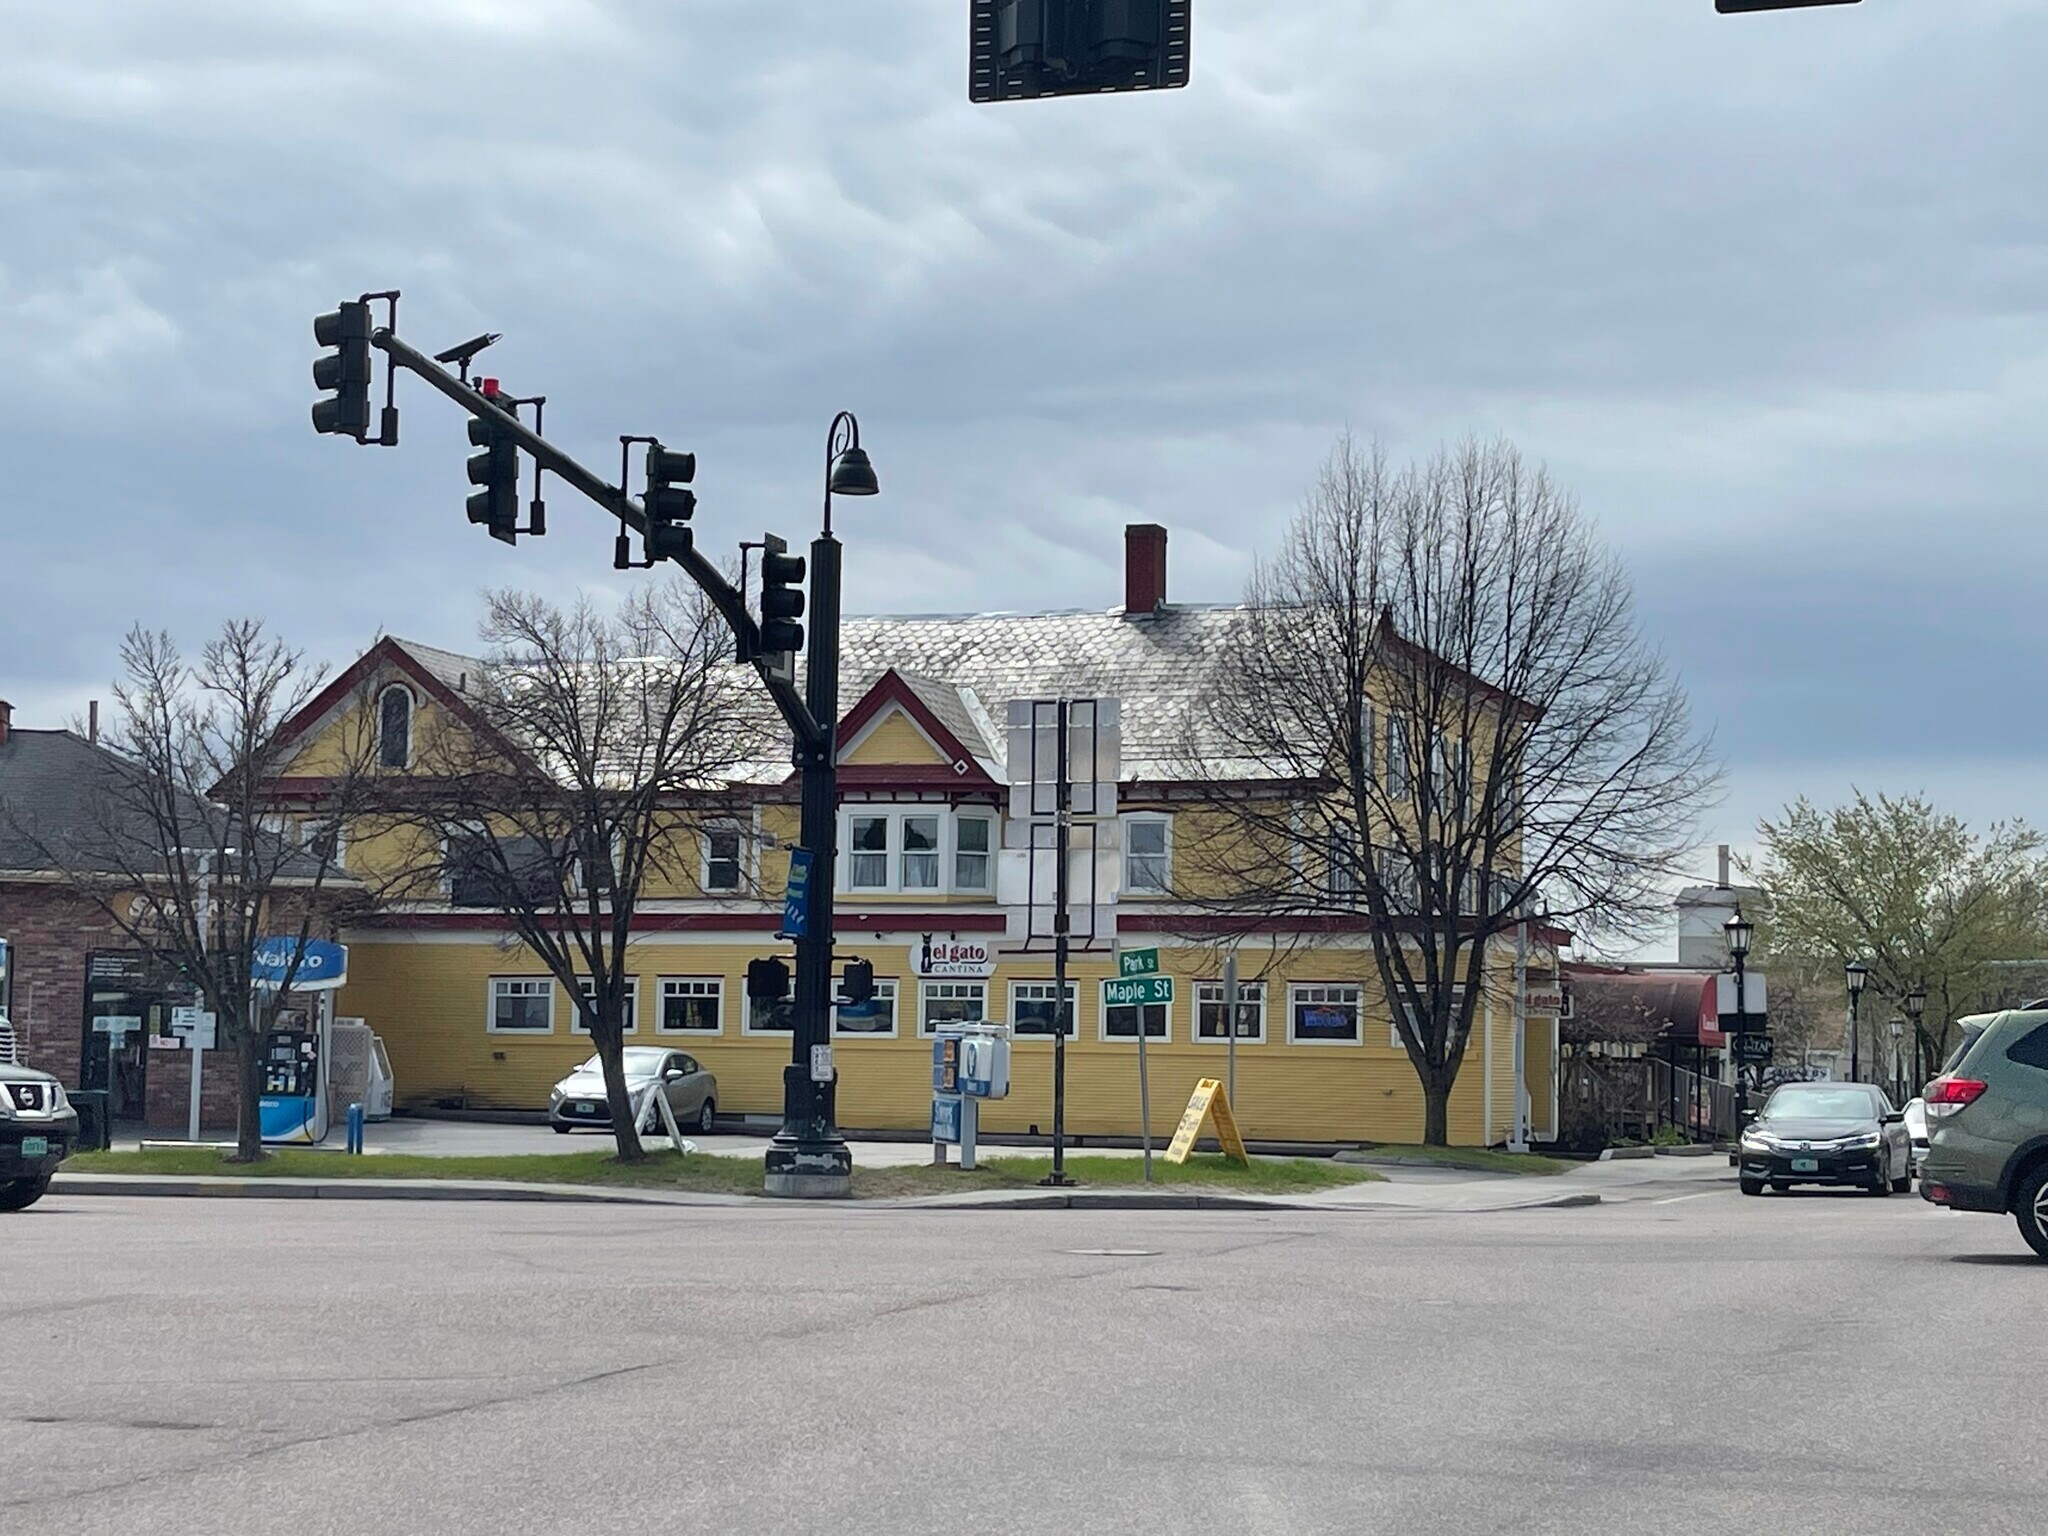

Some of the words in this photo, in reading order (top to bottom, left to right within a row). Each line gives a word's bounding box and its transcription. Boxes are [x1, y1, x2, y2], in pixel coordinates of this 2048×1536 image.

[933, 944, 946, 960] el
[950, 944, 985, 963] gato
[934, 965, 983, 973] CANTINA
[1123, 955, 1144, 972] Park
[1106, 981, 1145, 1003] Maple
[1154, 980, 1169, 998] St
